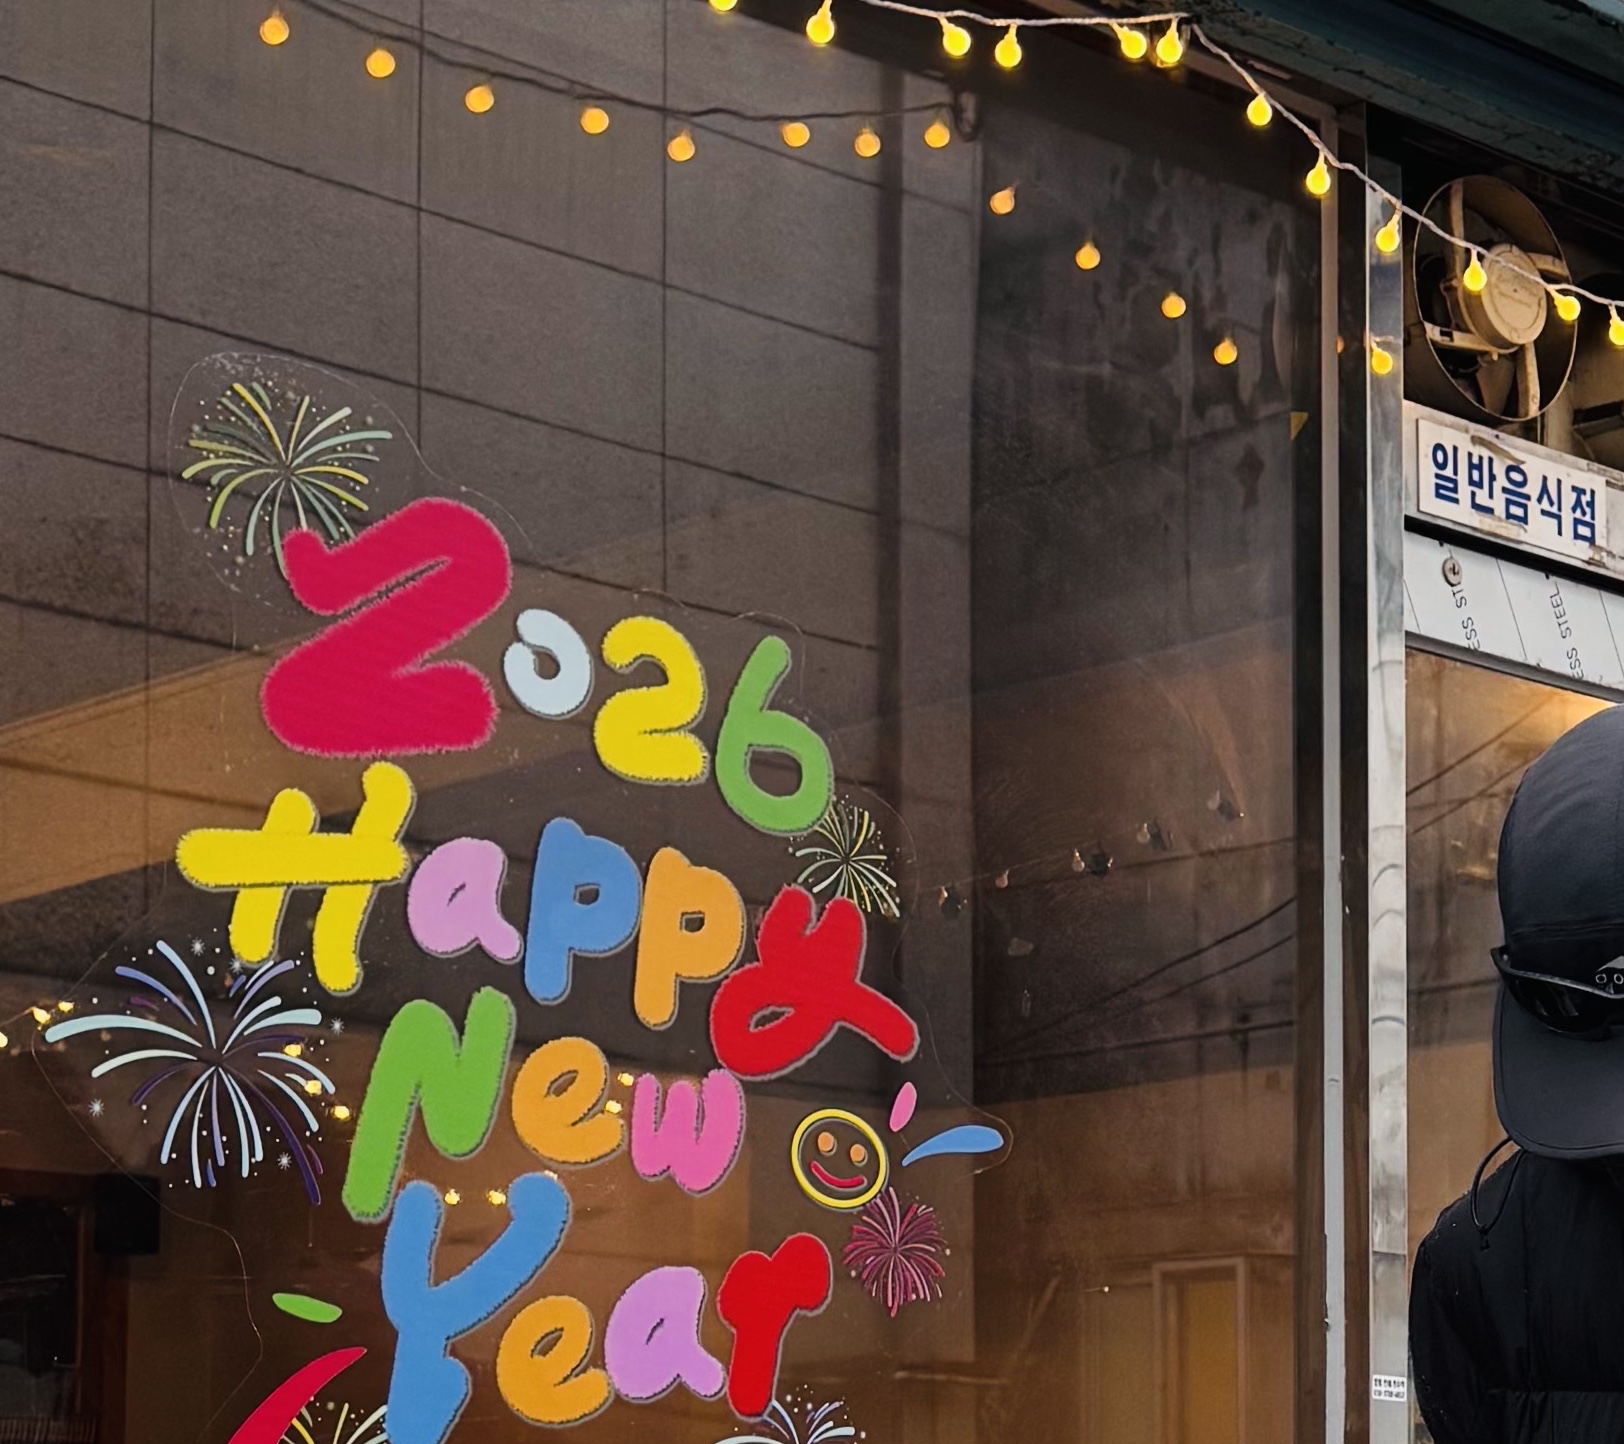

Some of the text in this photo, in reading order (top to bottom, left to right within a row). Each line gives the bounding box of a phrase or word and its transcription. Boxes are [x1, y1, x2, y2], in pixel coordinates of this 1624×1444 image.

[1432, 443, 1595, 545] 일반음식점
[261, 497, 834, 835] 2026
[176, 761, 918, 1080] Happy
[342, 986, 745, 1222] New
